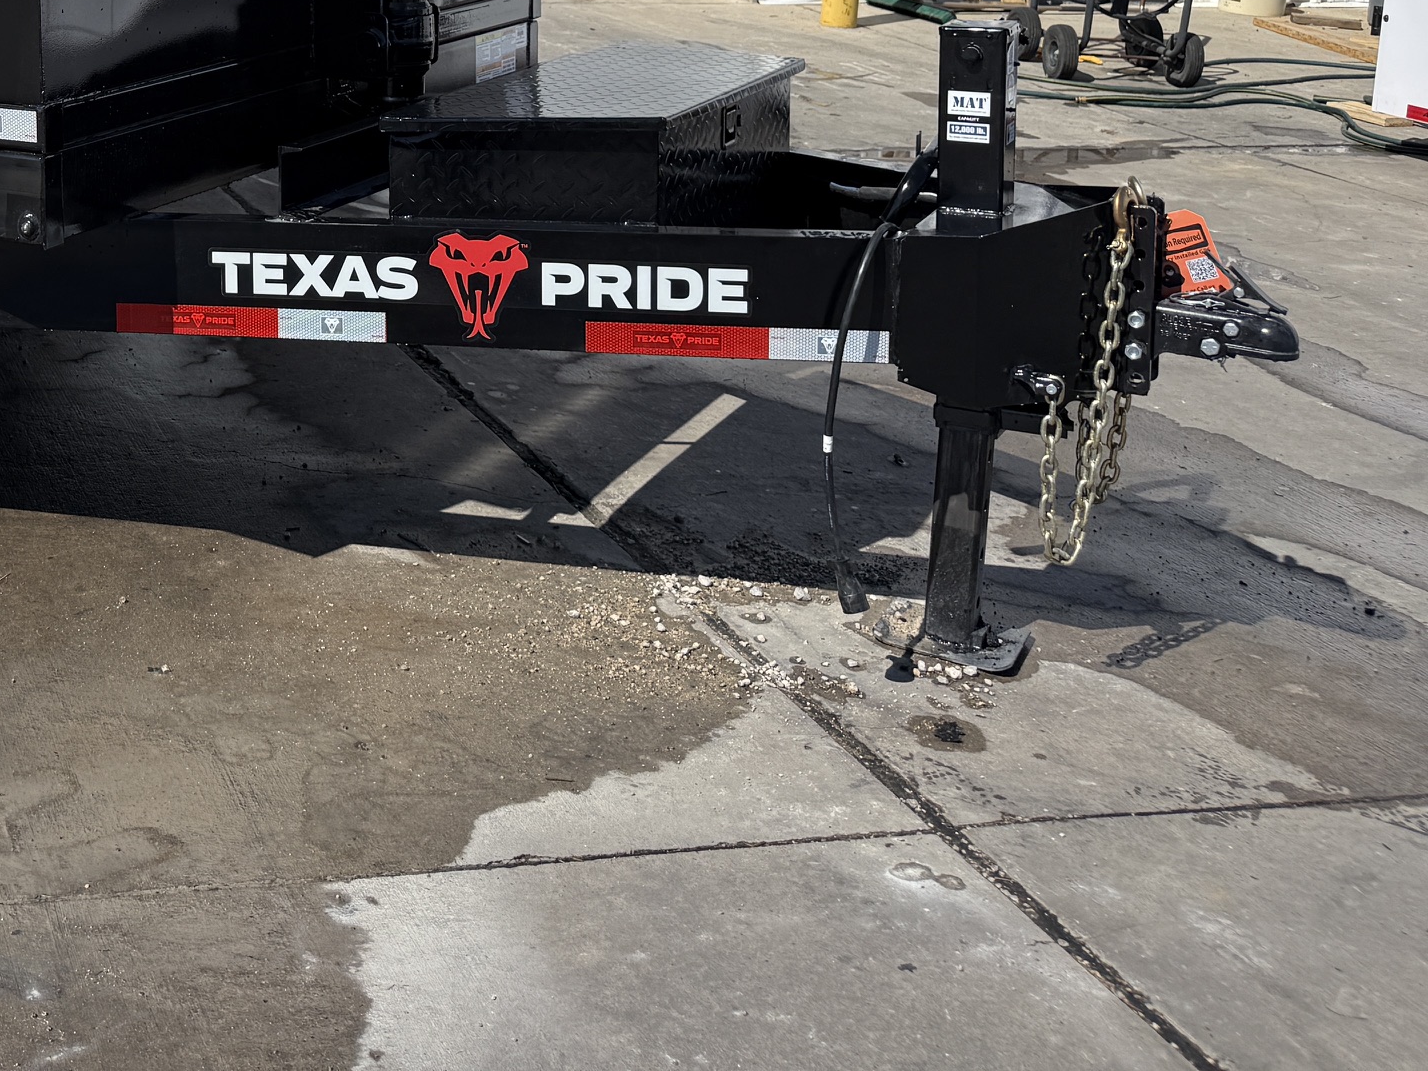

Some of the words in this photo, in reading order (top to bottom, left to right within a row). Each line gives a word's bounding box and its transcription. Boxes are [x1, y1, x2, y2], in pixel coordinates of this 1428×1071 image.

[953, 96, 987, 109] MAT
[1172, 232, 1202, 246] Required
[211, 251, 418, 300] TEXAS
[541, 262, 749, 314] PRIDE
[205, 317, 235, 325] PRIDE
[635, 334, 670, 343] TEXAS
[687, 336, 720, 345] PRIDE
